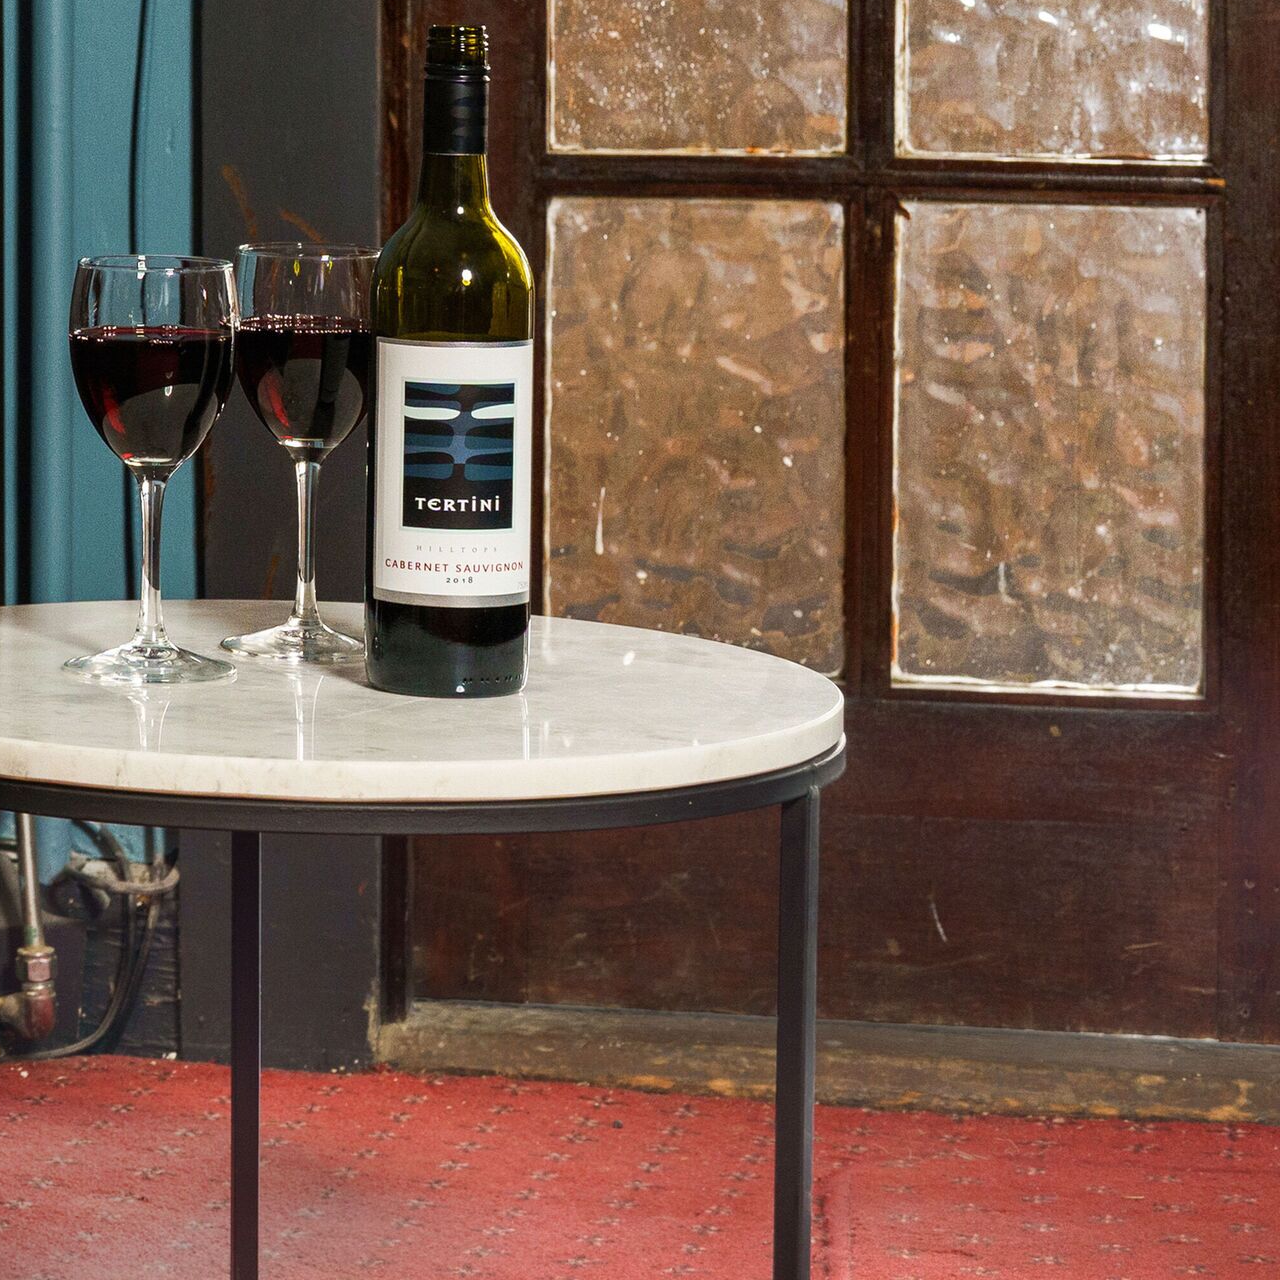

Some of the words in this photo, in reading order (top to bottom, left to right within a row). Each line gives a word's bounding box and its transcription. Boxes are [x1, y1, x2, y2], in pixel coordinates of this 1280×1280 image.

[385, 558, 449, 573] CABERNET
[455, 561, 524, 573] SAUVIGNON
[446, 576, 474, 584] 2018
